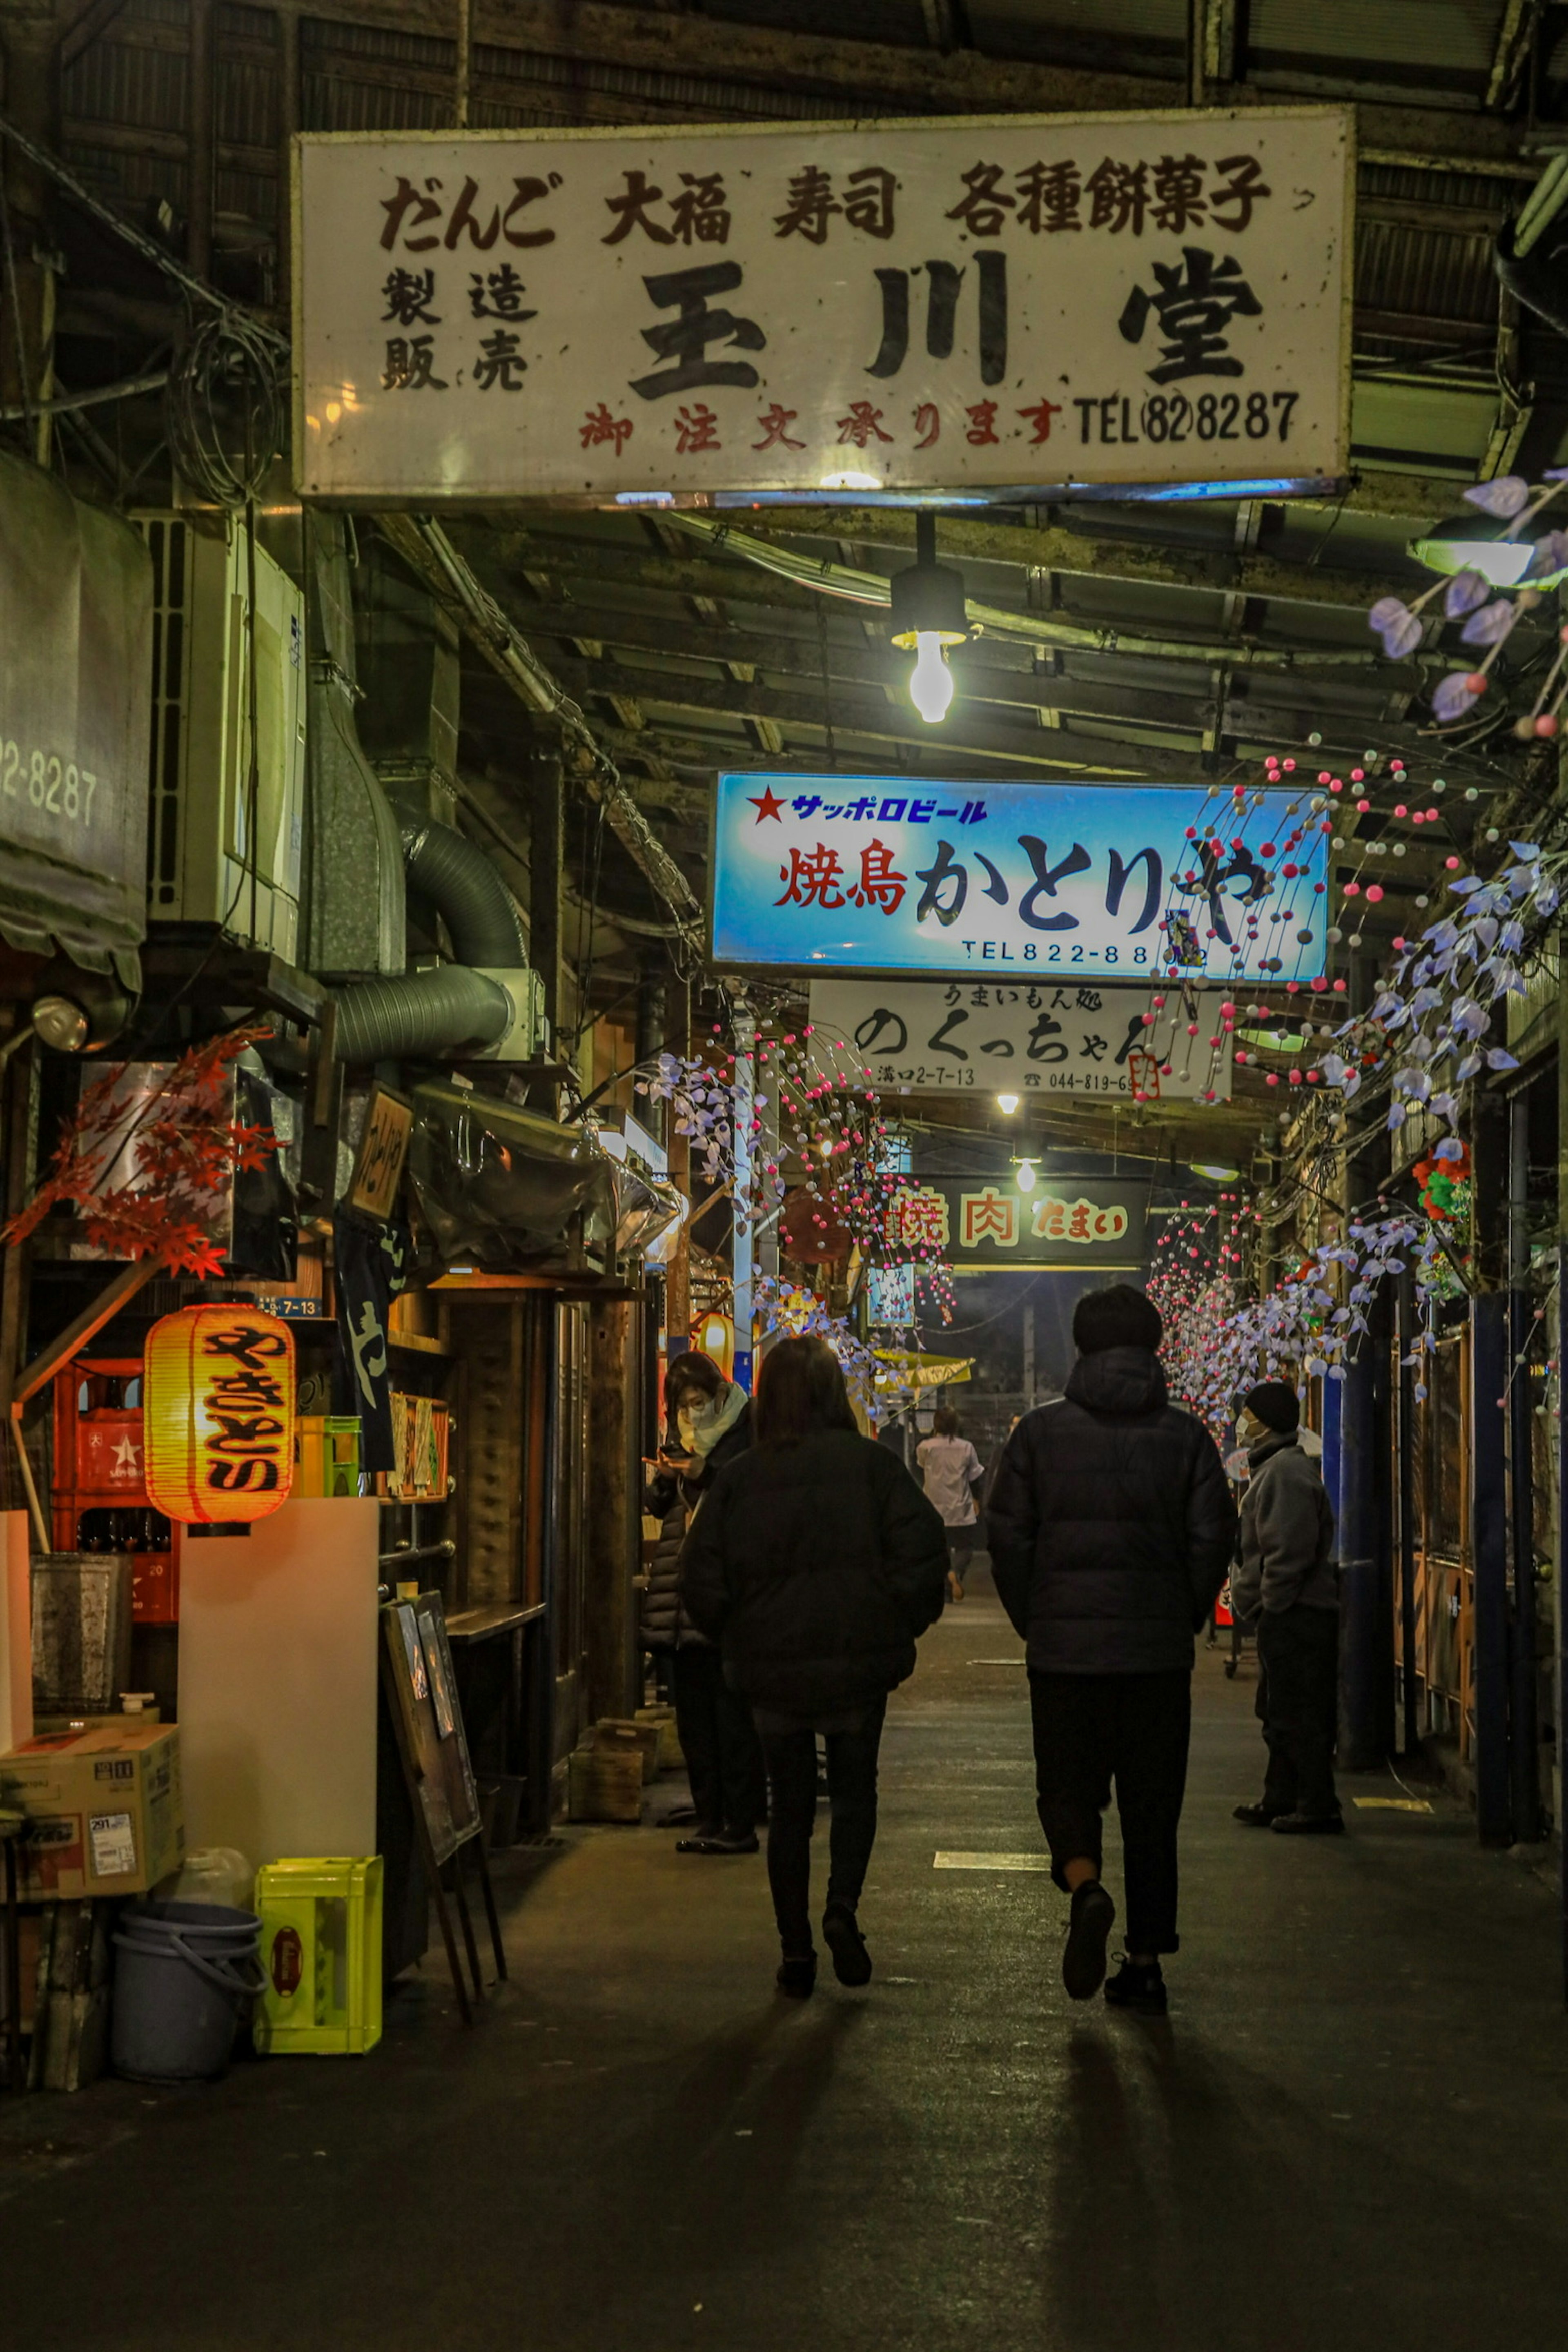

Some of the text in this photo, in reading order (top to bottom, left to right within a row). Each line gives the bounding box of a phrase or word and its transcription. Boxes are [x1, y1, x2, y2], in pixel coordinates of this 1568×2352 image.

[379, 154, 1270, 251] だんご 大福 寿司 各種餅菓子
[381, 263, 538, 325] 製造
[629, 247, 1263, 400] 玉川堂
[382, 330, 528, 390] 販売
[580, 398, 1062, 456] 御注文承ります
[0, 737, 96, 826] 2-8287
[791, 795, 988, 825] サッポロビール
[944, 984, 1102, 1011] うまいもん処
[855, 1008, 1169, 1065] のくっちゃん
[283, 1300, 316, 1315] 7-13
[204, 1327, 287, 1490] やきとり
